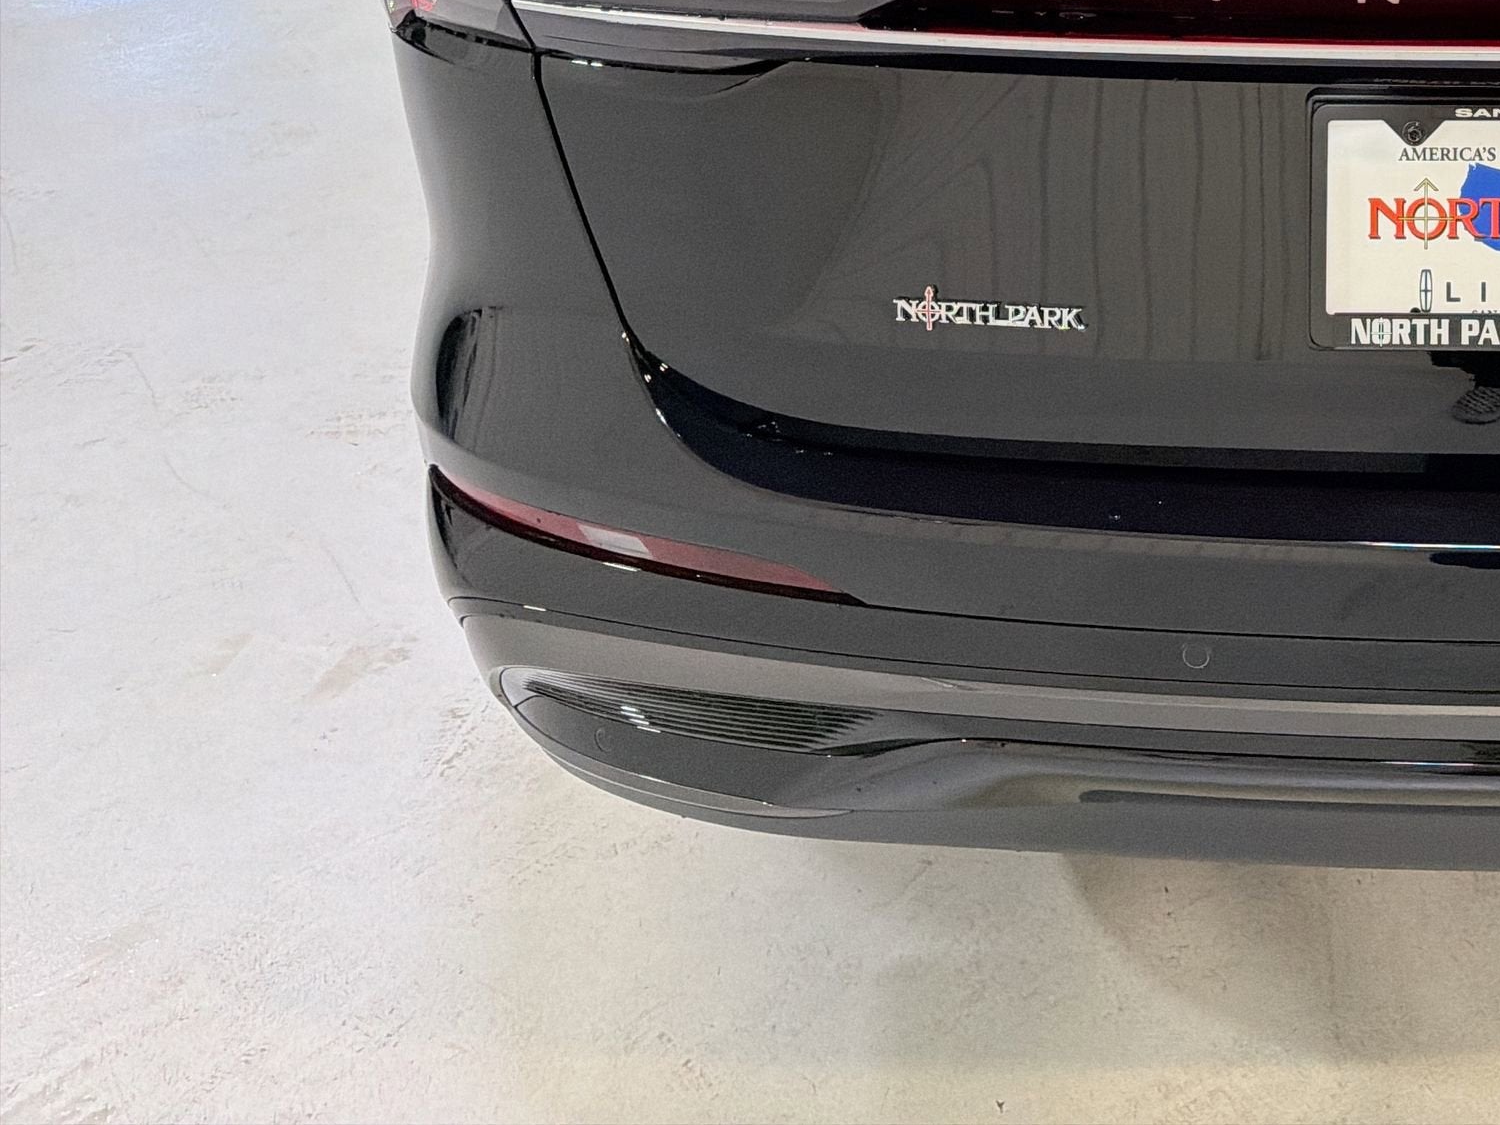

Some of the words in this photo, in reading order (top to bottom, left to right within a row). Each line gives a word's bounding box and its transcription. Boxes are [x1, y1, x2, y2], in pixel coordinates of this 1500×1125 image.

[1398, 146, 1497, 163] AMERICA'S
[892, 298, 998, 326] NORTH
[1004, 304, 1086, 331] PARK
[1351, 318, 1450, 346] NORTH
